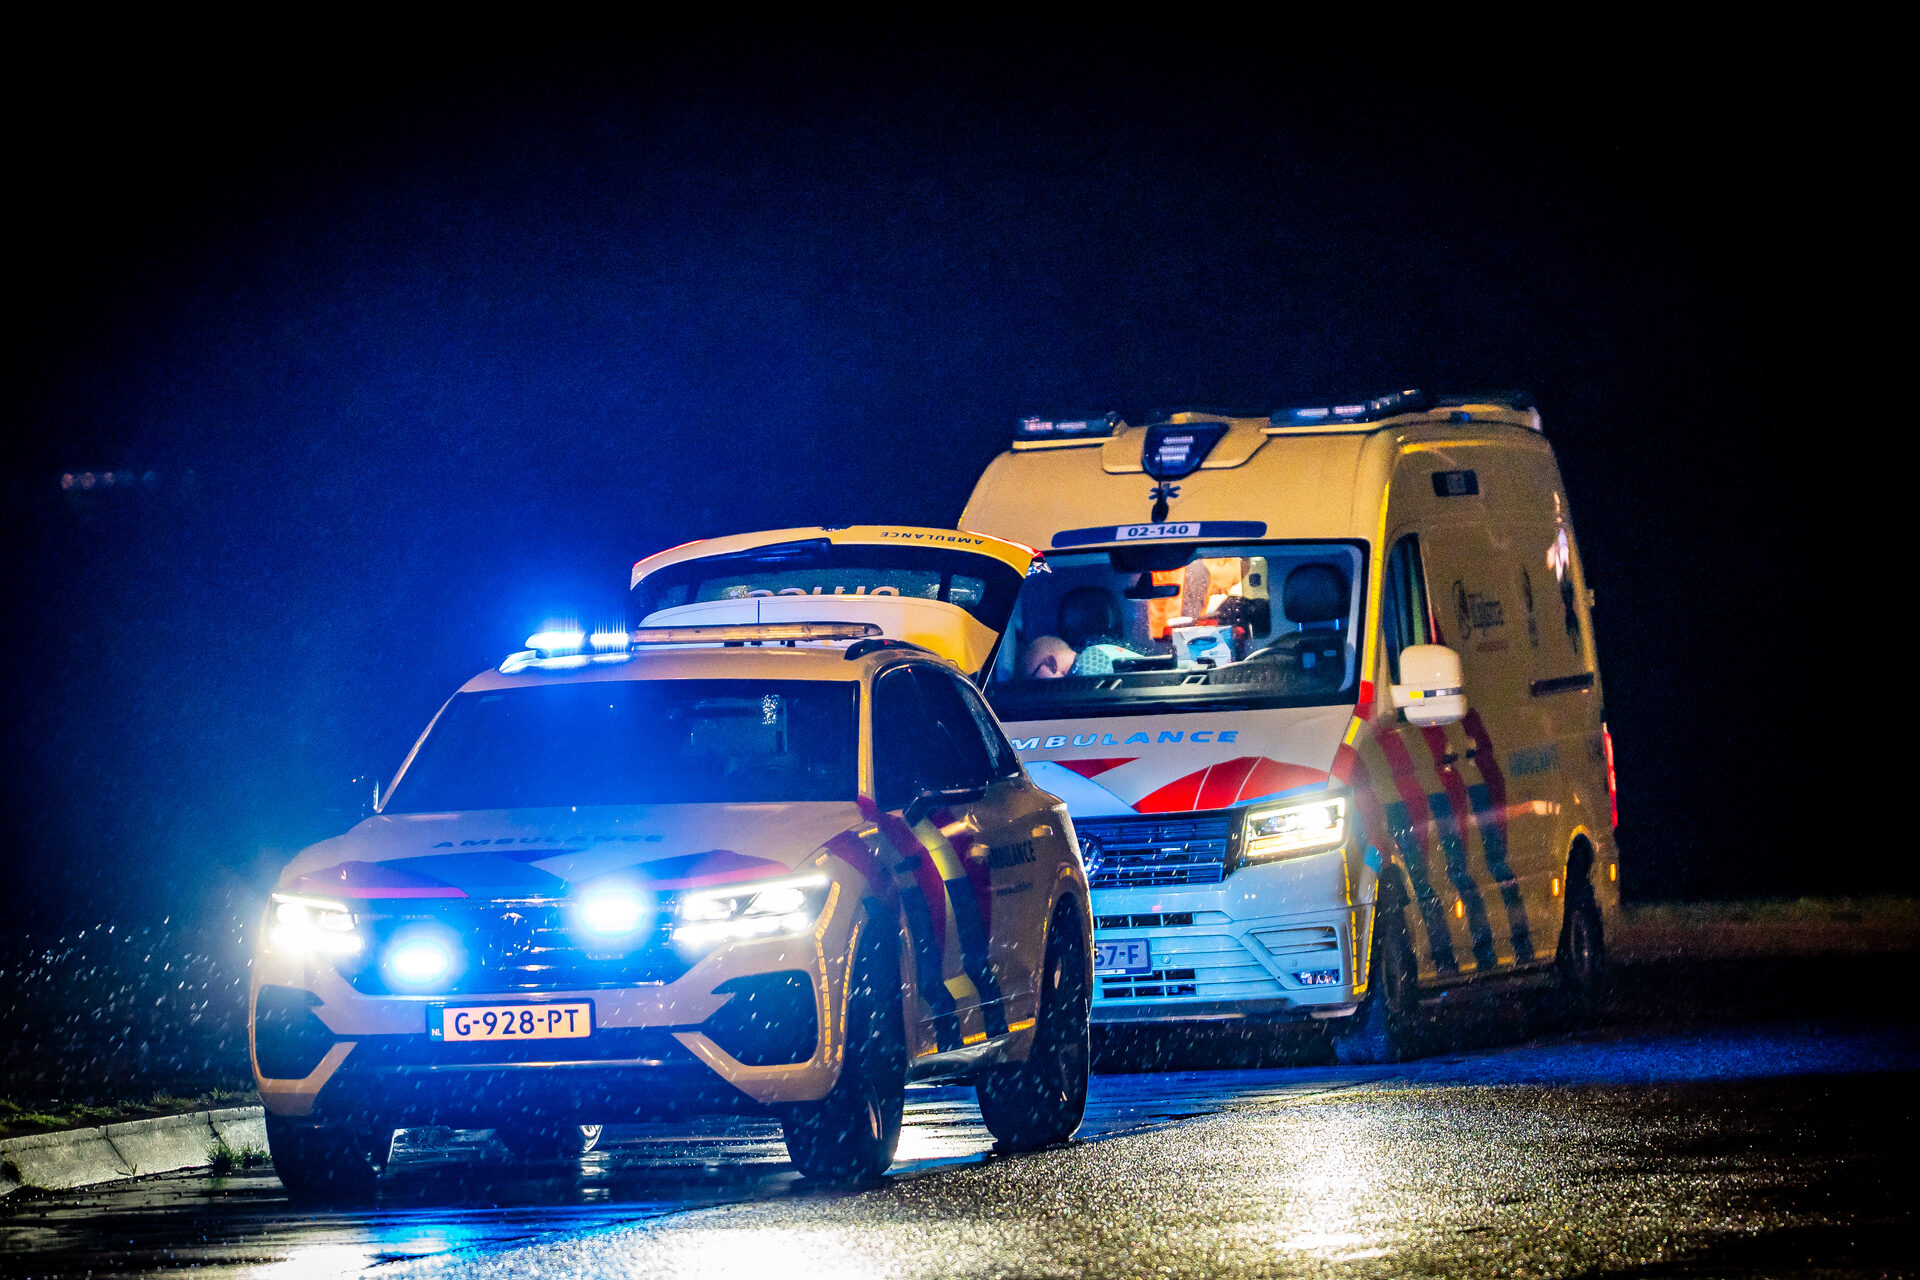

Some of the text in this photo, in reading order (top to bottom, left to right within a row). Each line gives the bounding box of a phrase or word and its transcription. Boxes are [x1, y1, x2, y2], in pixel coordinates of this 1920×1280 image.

[880, 531, 984, 545] AMBULANCE
[1127, 525, 1189, 537] 02-140
[1010, 730, 1239, 750] MBULANCE
[432, 833, 664, 849] AMBULANCE
[431, 1009, 579, 1037] NL G-928-PT
